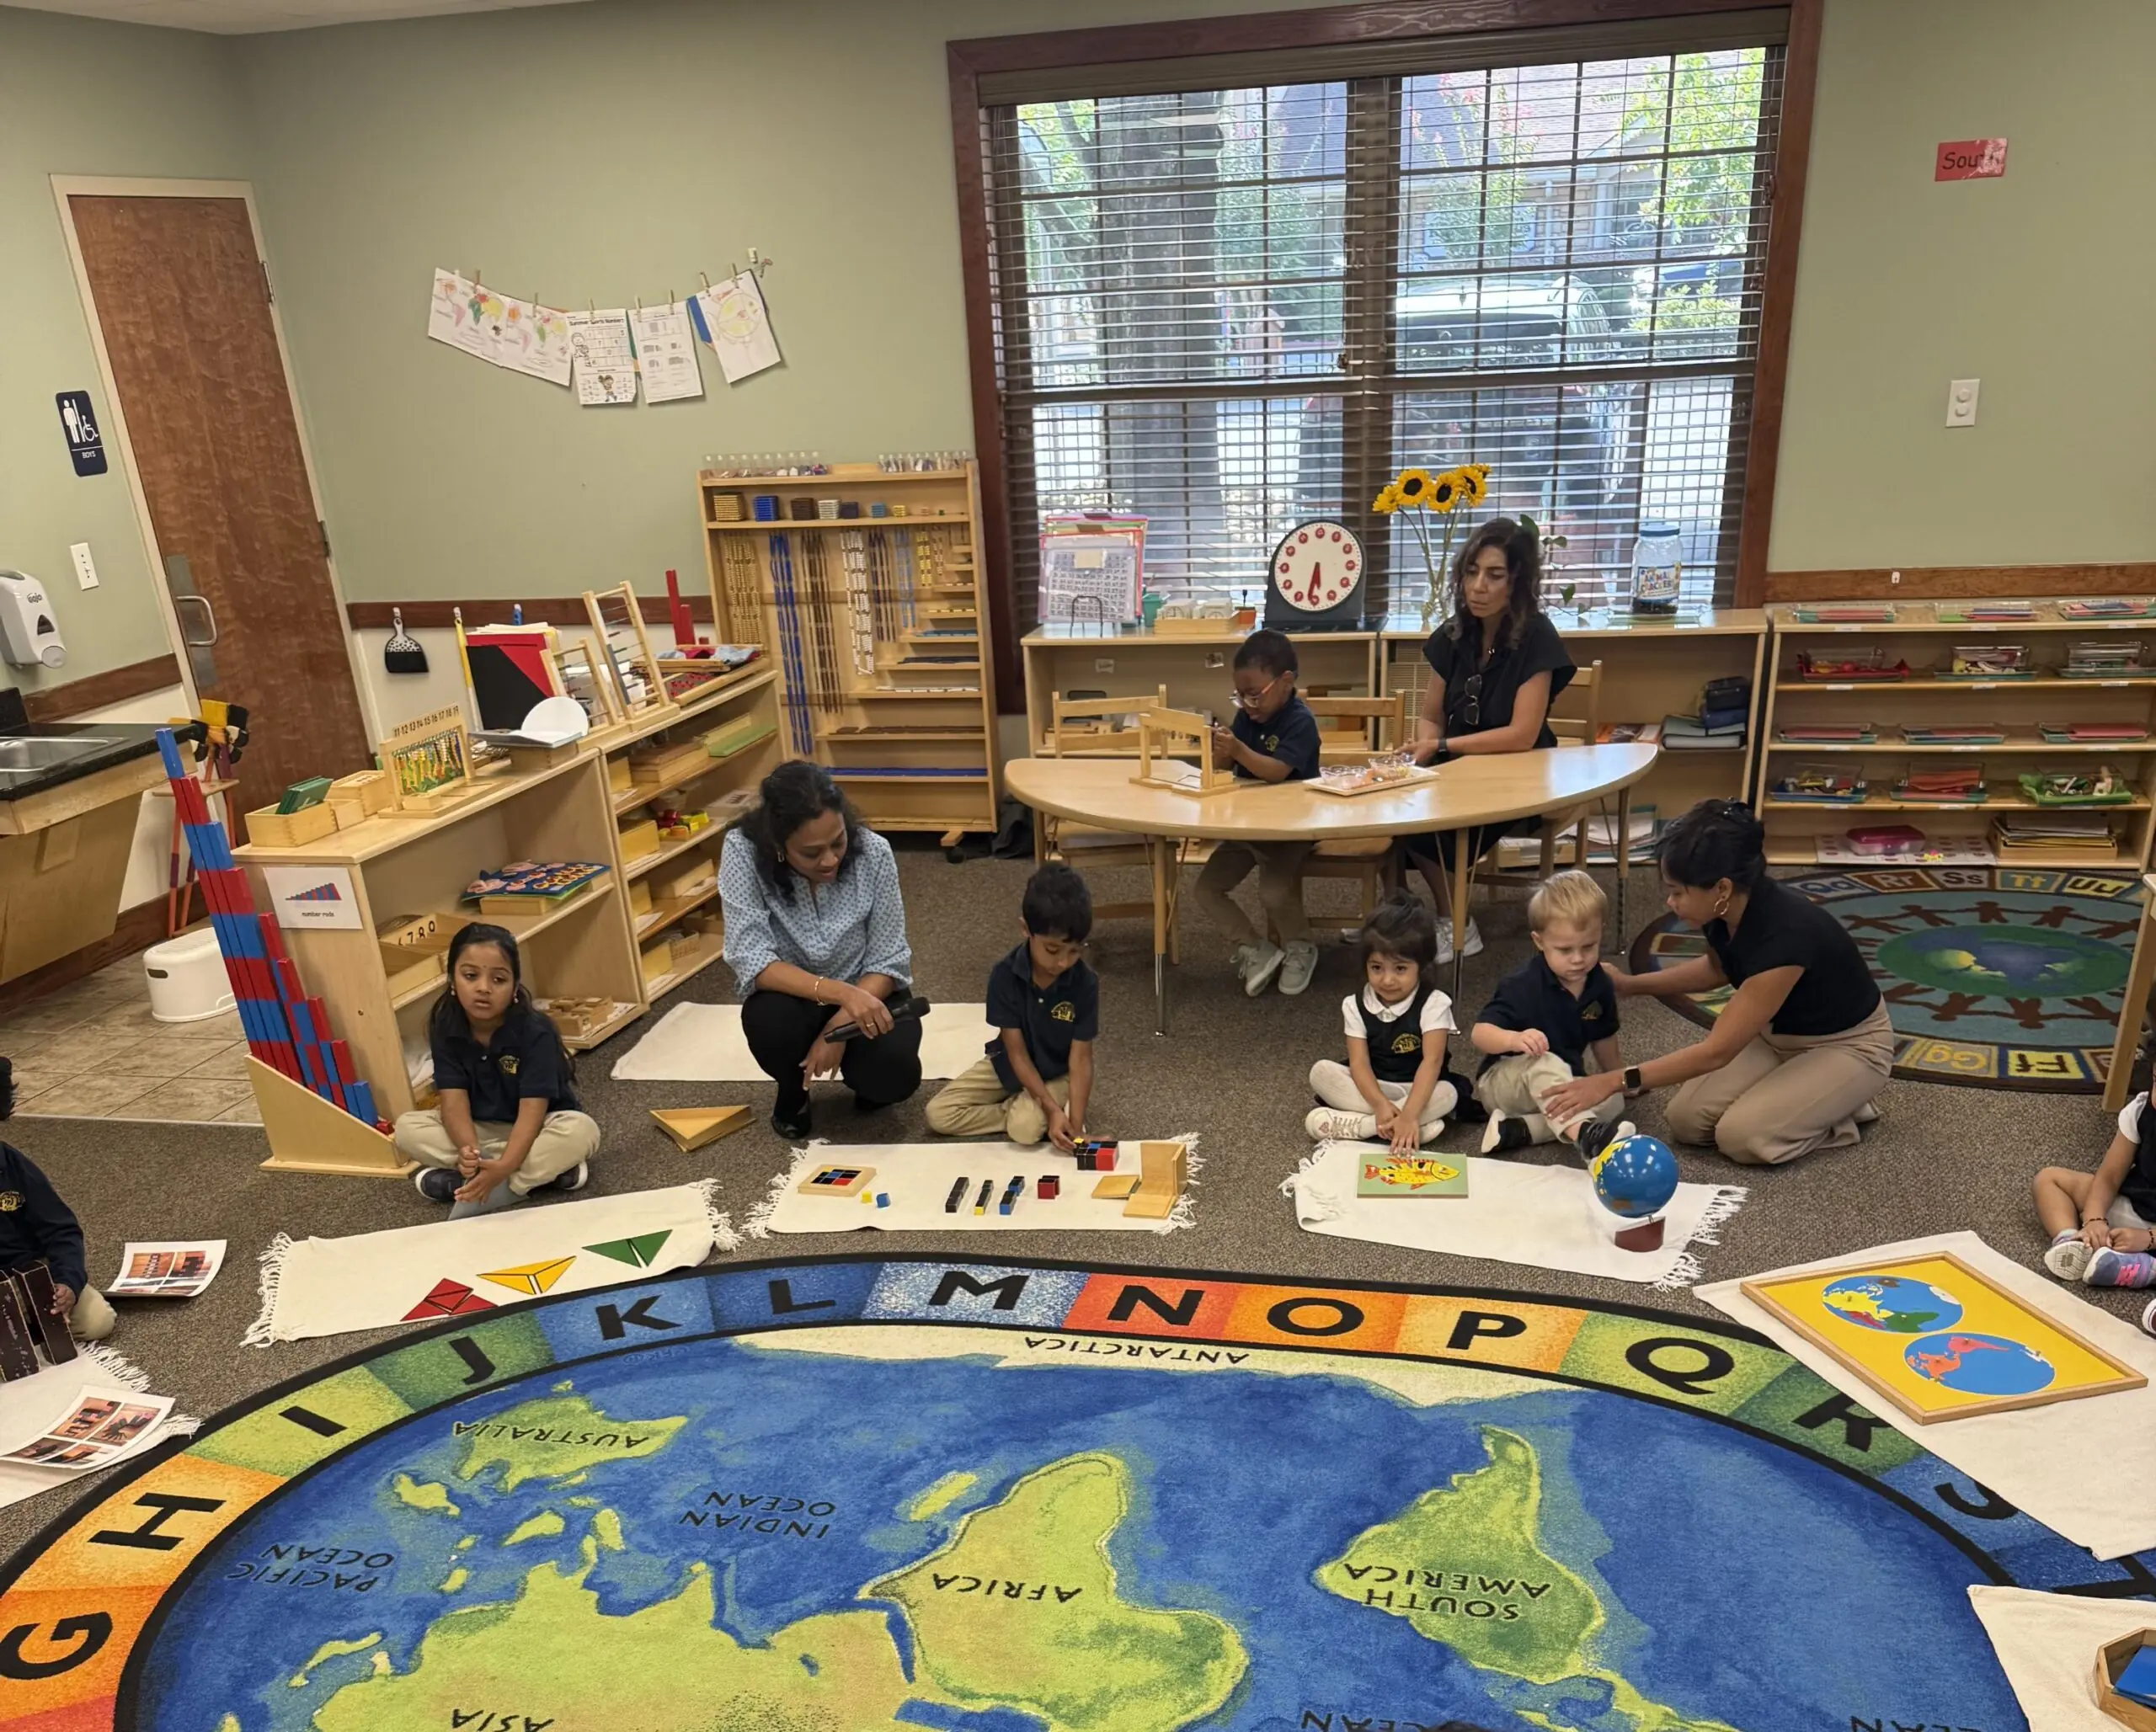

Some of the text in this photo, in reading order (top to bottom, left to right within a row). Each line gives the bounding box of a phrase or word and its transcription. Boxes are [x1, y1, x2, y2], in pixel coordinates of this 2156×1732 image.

[82, 450, 97, 459] BOYS
[394, 727, 400, 738] 11
[401, 724, 408, 734] 12
[409, 721, 416, 731] 13
[424, 716, 431, 725] 15
[431, 713, 438, 723] 16
[438, 711, 445, 720] 17
[446, 708, 452, 717] 18
[1873, 874, 1914, 887] Rr
[1942, 871, 1983, 884] Ss
[1924, 1044, 1986, 1071] Gg
[2015, 1053, 2071, 1074] Ff
[1024, 1336, 1250, 1364] ANTARCTICA
[453, 1421, 649, 1449] AUSTRALIA
[1, 1612, 113, 1681] G
[87, 1492, 227, 1551] H
[279, 1405, 347, 1437] I
[448, 1335, 496, 1386] J
[595, 1295, 681, 1341] K
[769, 1278, 836, 1314] L
[927, 1271, 1030, 1312] M
[1106, 1284, 1205, 1326] N
[1267, 1297, 1365, 1337] O
[1446, 1310, 1527, 1351] P
[1625, 1336, 1734, 1395] Q
[704, 1490, 836, 1517] OCEAN
[679, 1511, 830, 1539] INDIAN
[260, 1543, 395, 1569] OCEAN
[227, 1562, 380, 1592] PACIFIC
[932, 1573, 1083, 1604] AFRICA
[1344, 1564, 1551, 1599] AMERICA
[1367, 1588, 1519, 1620] SOUTH
